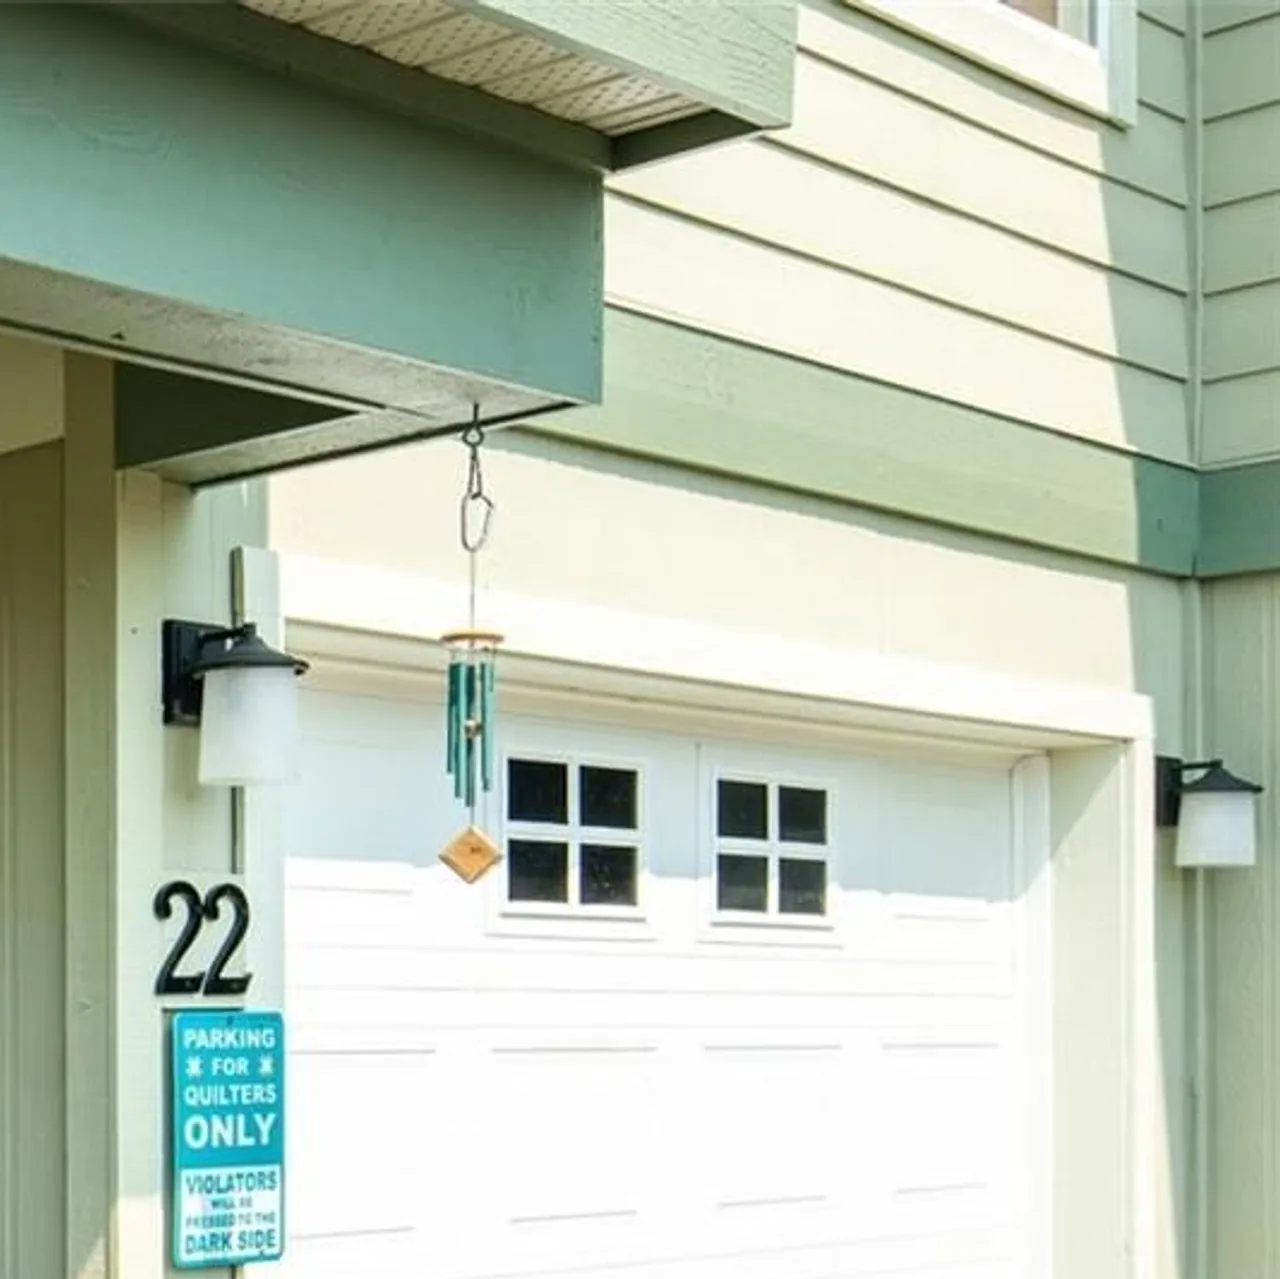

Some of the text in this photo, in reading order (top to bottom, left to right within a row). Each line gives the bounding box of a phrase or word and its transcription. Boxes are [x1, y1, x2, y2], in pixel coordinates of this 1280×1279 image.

[153, 880, 253, 996] 22
[183, 1027, 276, 1049] PARKING
[211, 1056, 250, 1076] FOR
[184, 1083, 277, 1107] QUILTERS
[184, 1113, 277, 1149] ONLY
[185, 1170, 277, 1195] VIOLATORS
[185, 1228, 277, 1255] DARK SIDE
